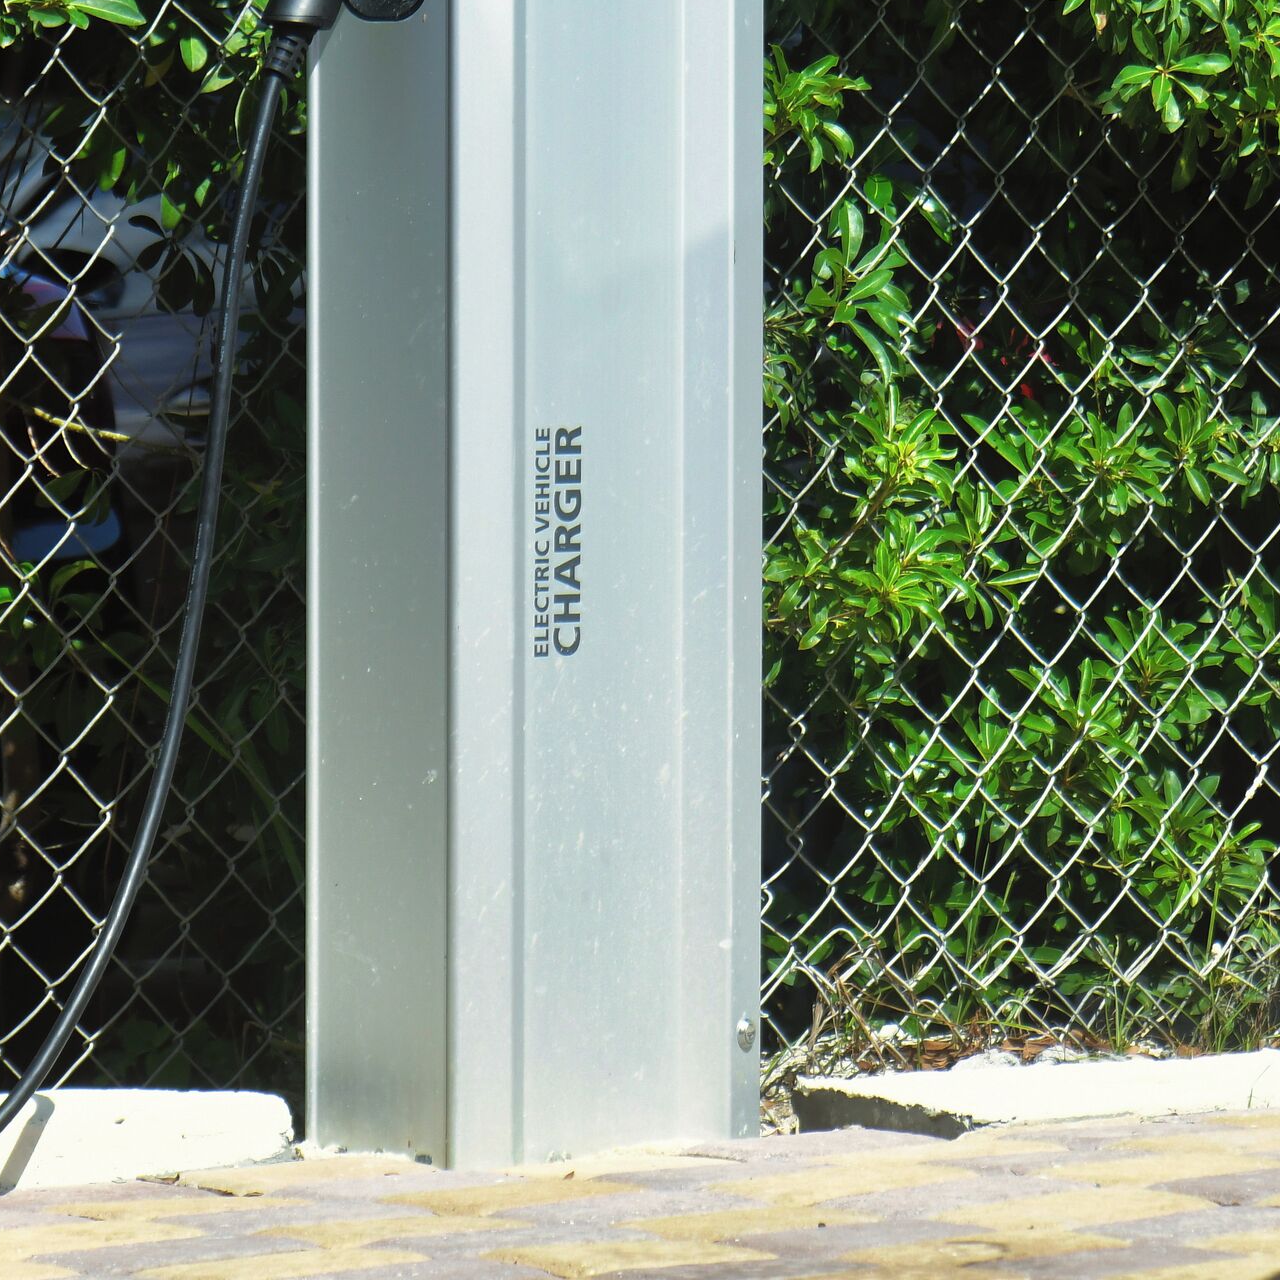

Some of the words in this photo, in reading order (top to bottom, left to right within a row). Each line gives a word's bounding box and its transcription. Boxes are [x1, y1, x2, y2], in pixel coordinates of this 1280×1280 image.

[535, 427, 550, 534] VEHICLE
[534, 540, 550, 657] ELECTRIC
[553, 426, 582, 656] CHARGER
